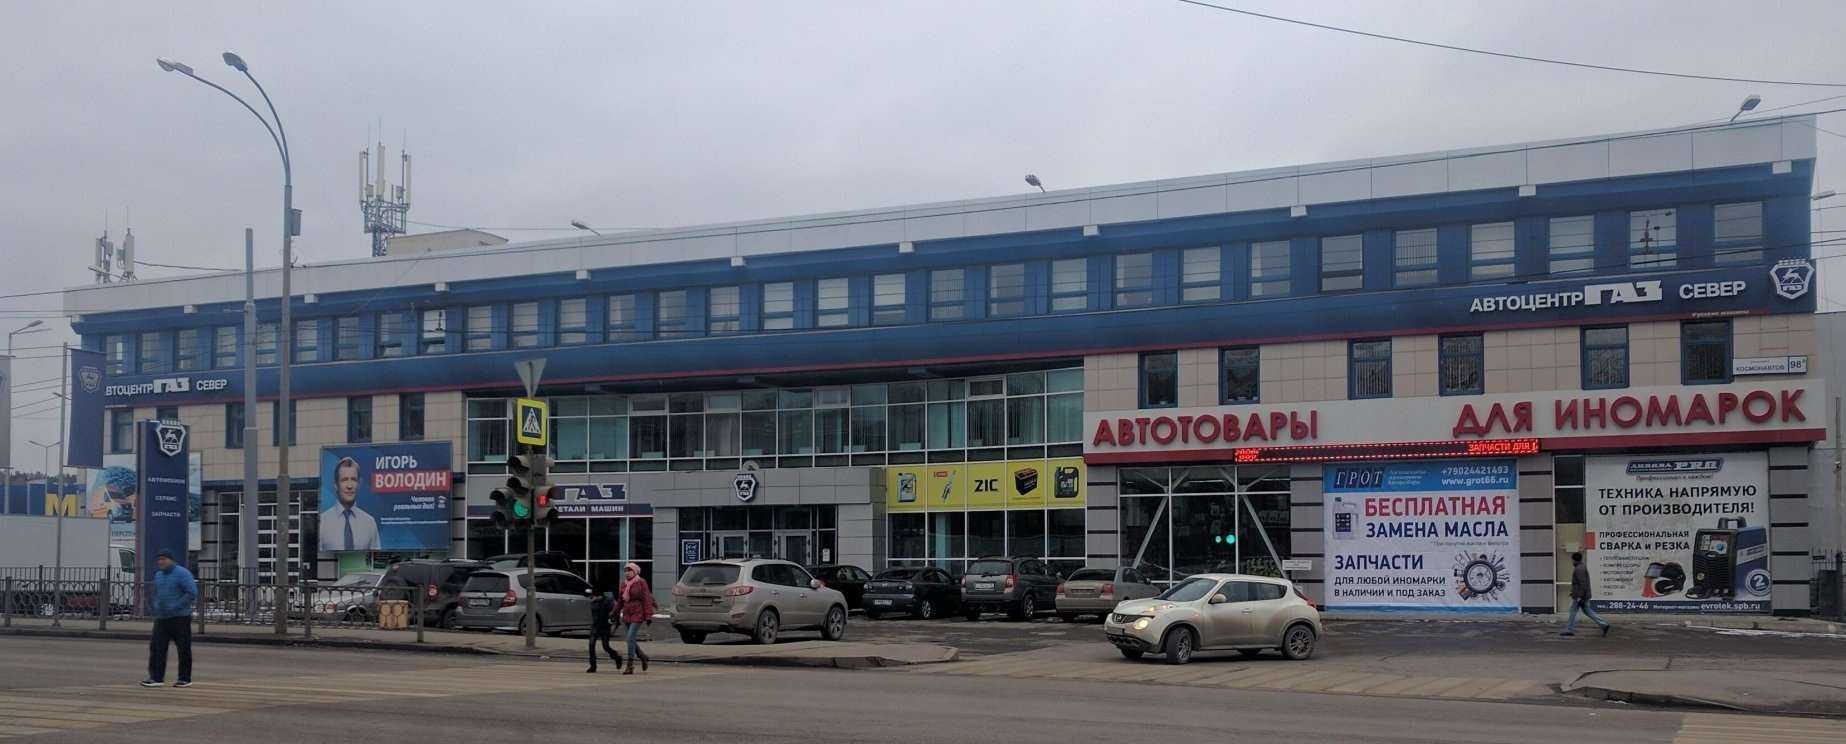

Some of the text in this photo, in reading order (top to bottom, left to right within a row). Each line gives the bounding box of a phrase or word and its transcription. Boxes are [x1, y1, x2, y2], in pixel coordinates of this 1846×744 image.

[1470, 280, 1746, 312] АВТОЦЕНТР ГАЗ СЕВЕР
[105, 383, 153, 397] ВТОЦЕНТР
[153, 377, 190, 394] ГАЗ
[196, 379, 228, 391] СЕВЕР
[1093, 389, 1806, 447] АВТОТОВАРЫ ДЛЯ ИНОМАРОК
[1469, 443, 1511, 452] ЗАПЧАСТИ
[1513, 441, 1529, 451] ДЛЯ
[375, 455, 418, 470] ИГОРЬ
[1441, 465, 1509, 475] +79024421493
[375, 471, 447, 490] ВОЛОДИН
[1335, 469, 1384, 486] ГРОТ
[1441, 476, 1509, 486] www.grot66.ru
[974, 478, 999, 493] ZIC
[1598, 485, 1757, 499] ТЕХНИКА НАПРЯМУЮ
[591, 505, 624, 513] МАШИН
[1598, 502, 1755, 517] ОТ ПРОИЗВОДИТЕЛЯ!
[1366, 520, 1509, 538] ЗАМЕНА МАСЛА
[1599, 541, 1642, 550] СВАРКА
[1655, 541, 1690, 550] РЕЗКА
[1334, 554, 1424, 570] ЗАПЧАСТИ
[1334, 575, 1446, 586] ДЛЯ ЛЮБОЙ ИНОМАРКИ
[1753, 575, 1765, 587] 2
[1342, 589, 1385, 597] НАЛИЧИИ
[1387, 589, 1392, 597] И
[1396, 589, 1415, 598] ПОД
[1417, 589, 1446, 597] ЗАКАЗ
[1609, 601, 1649, 609] 288-24-46
[1701, 601, 1761, 610] evrotek.spb.ru
